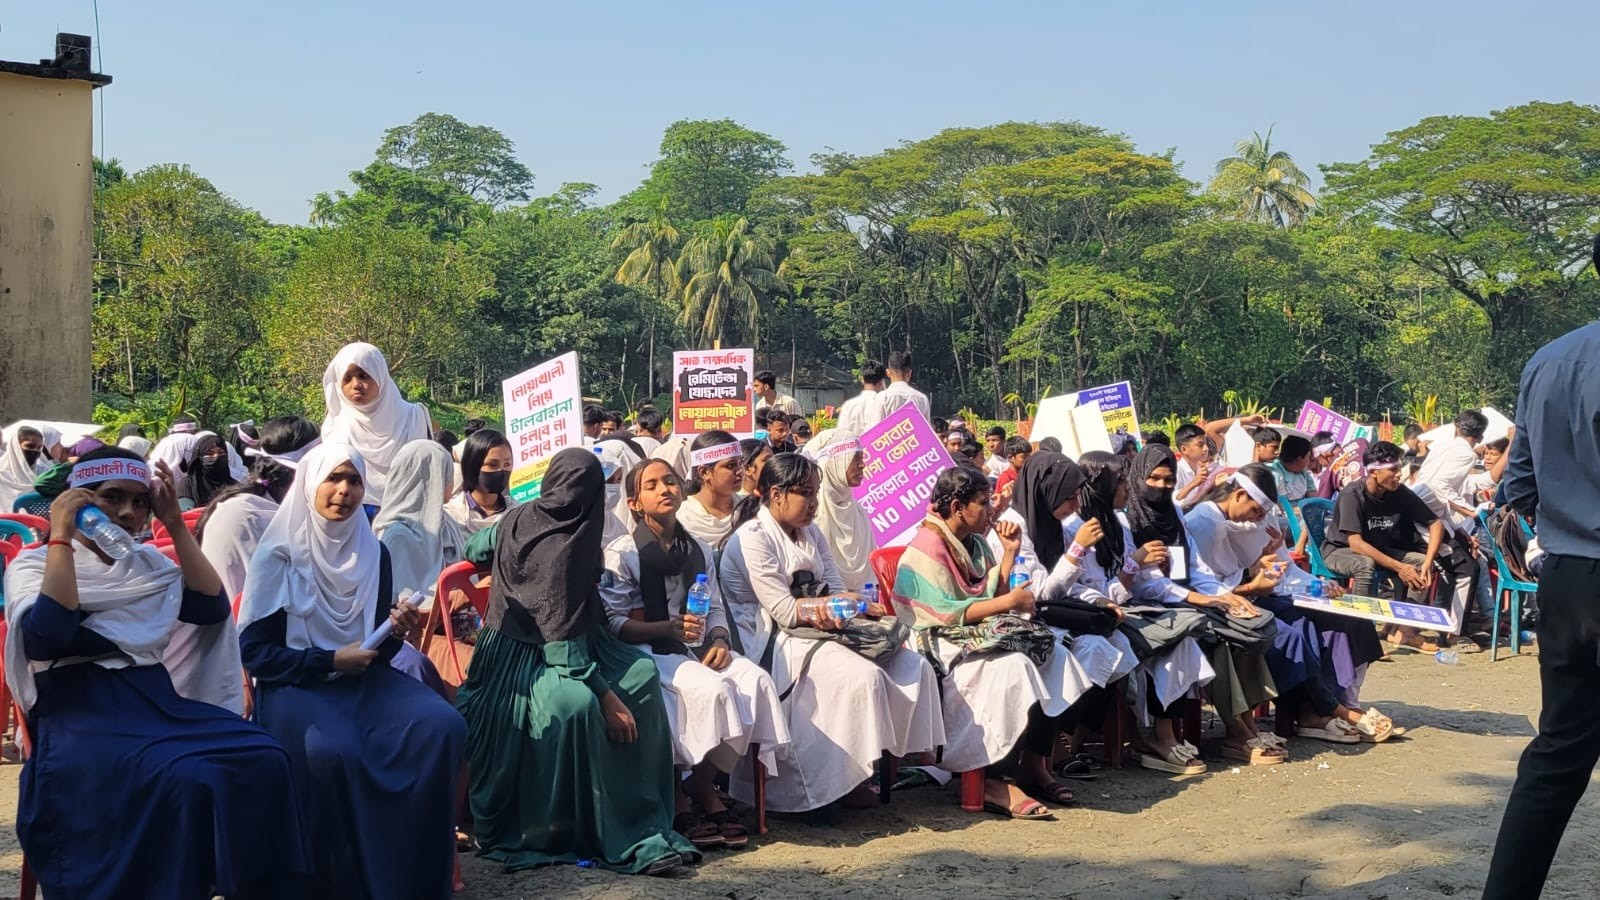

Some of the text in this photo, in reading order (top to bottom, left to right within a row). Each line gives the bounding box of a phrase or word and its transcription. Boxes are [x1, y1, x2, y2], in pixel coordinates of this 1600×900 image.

[680, 352, 746, 366] সাত লক্ষাধিক
[511, 360, 565, 402] নোয়াখালী
[688, 386, 737, 399] যোদ্ধাদের
[528, 389, 553, 411] নিয়ে
[679, 403, 747, 420] নোয়াখালীকে
[510, 397, 573, 434] টালবাহানা
[520, 417, 566, 446] চলবে না
[870, 417, 914, 451] আবার
[521, 433, 567, 462] চলবে না
[886, 434, 920, 463] জোর
[857, 447, 941, 514] কুমিল্লার সাথে
[871, 465, 946, 533] NO MOR
